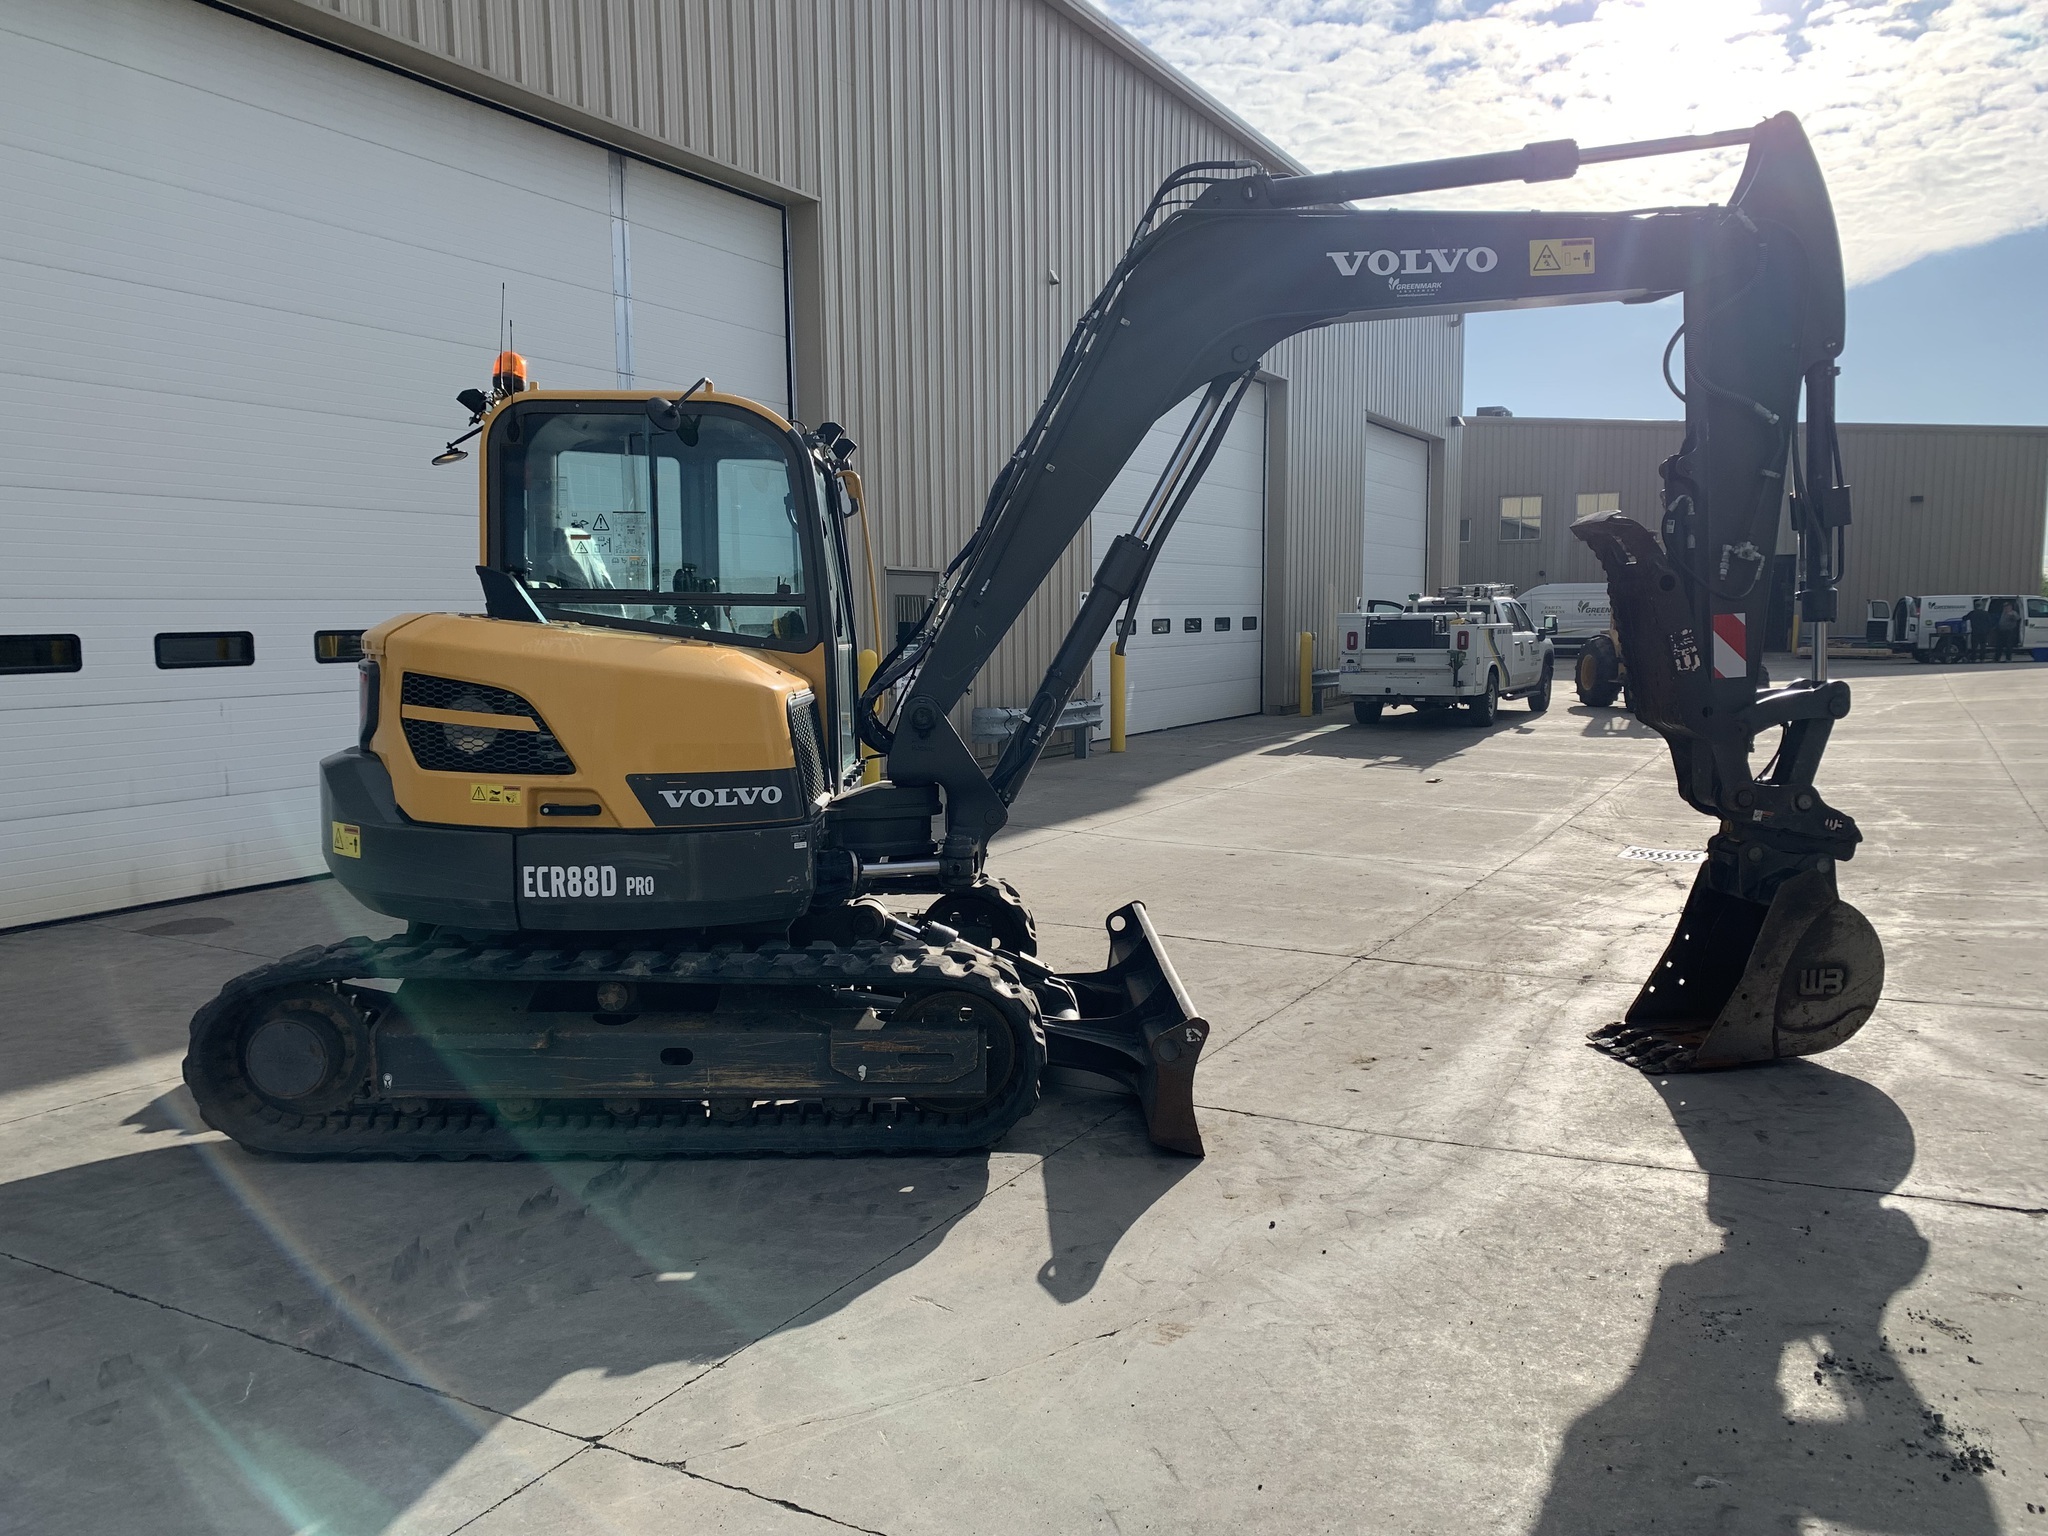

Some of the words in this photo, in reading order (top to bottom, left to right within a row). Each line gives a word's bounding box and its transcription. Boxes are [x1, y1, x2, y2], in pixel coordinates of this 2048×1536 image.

[1326, 246, 1498, 276] VOLVO
[1396, 282, 1442, 291] GREENMARK
[658, 785, 783, 808] VOLVO
[522, 865, 617, 898] ECR88D
[626, 875, 655, 897] PRO
